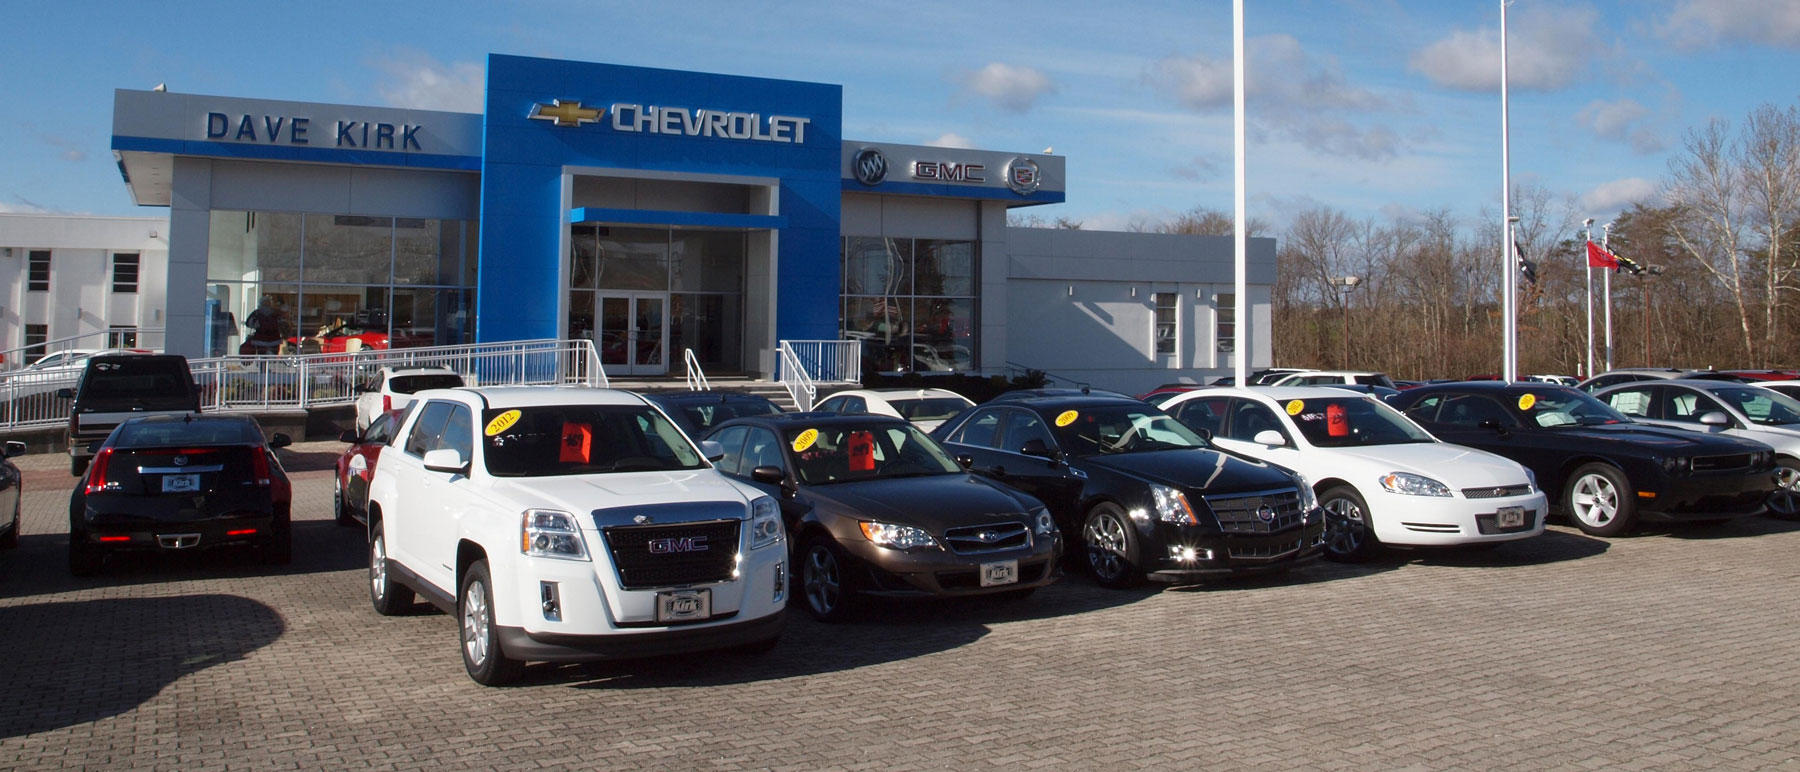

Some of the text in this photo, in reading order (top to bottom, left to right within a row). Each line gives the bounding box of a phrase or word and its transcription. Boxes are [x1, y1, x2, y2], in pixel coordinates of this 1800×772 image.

[207, 111, 422, 150] DAVE KIRK
[611, 103, 811, 144] CHEVROLET
[913, 161, 986, 182] GMC
[491, 412, 515, 432] 2012
[797, 431, 813, 449] 2009
[649, 536, 708, 553] GMC
[672, 599, 699, 611] Kirk
